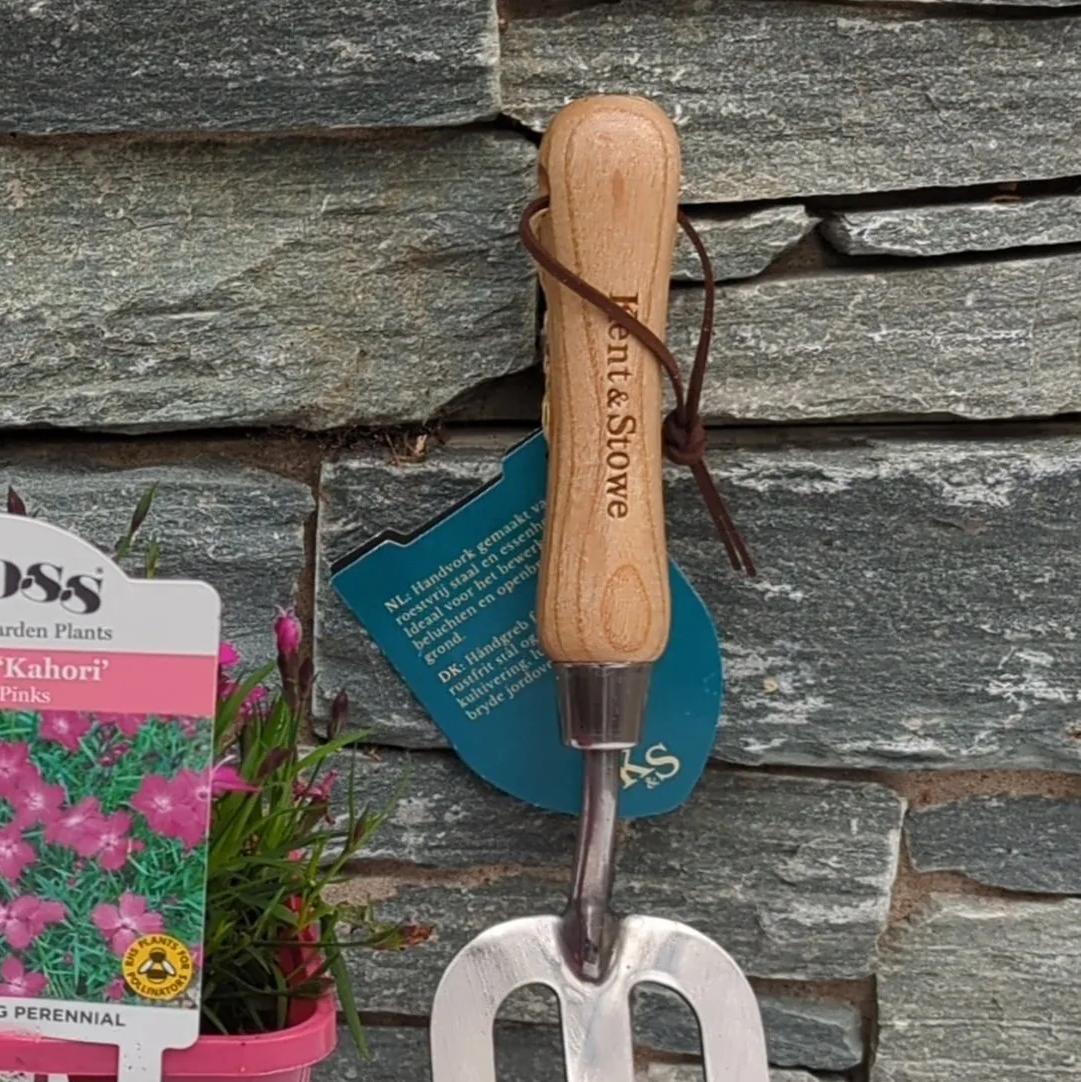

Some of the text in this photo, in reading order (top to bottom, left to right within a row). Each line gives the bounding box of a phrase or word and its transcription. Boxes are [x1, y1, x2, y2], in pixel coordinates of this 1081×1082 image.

[607, 387, 629, 408] &
[606, 413, 637, 519] Stowe
[384, 593, 412, 613] NL:
[410, 548, 476, 596] Handvork
[476, 510, 531, 555] gemaakt
[396, 585, 450, 626] roestvrij
[449, 564, 480, 590] staal
[481, 554, 499, 569] en
[403, 607, 444, 638] Ideaal
[444, 588, 475, 611] voor
[474, 572, 498, 591] het
[54, 623, 113, 640] Plants
[412, 605, 477, 650] beluchten
[478, 594, 496, 608] en
[438, 663, 466, 684] DK:
[449, 663, 495, 696] rustfrit
[0, 686, 51, 704] Pinks
[466, 694, 506, 721] bryde
[14, 1006, 126, 1027] PERENNIAL
